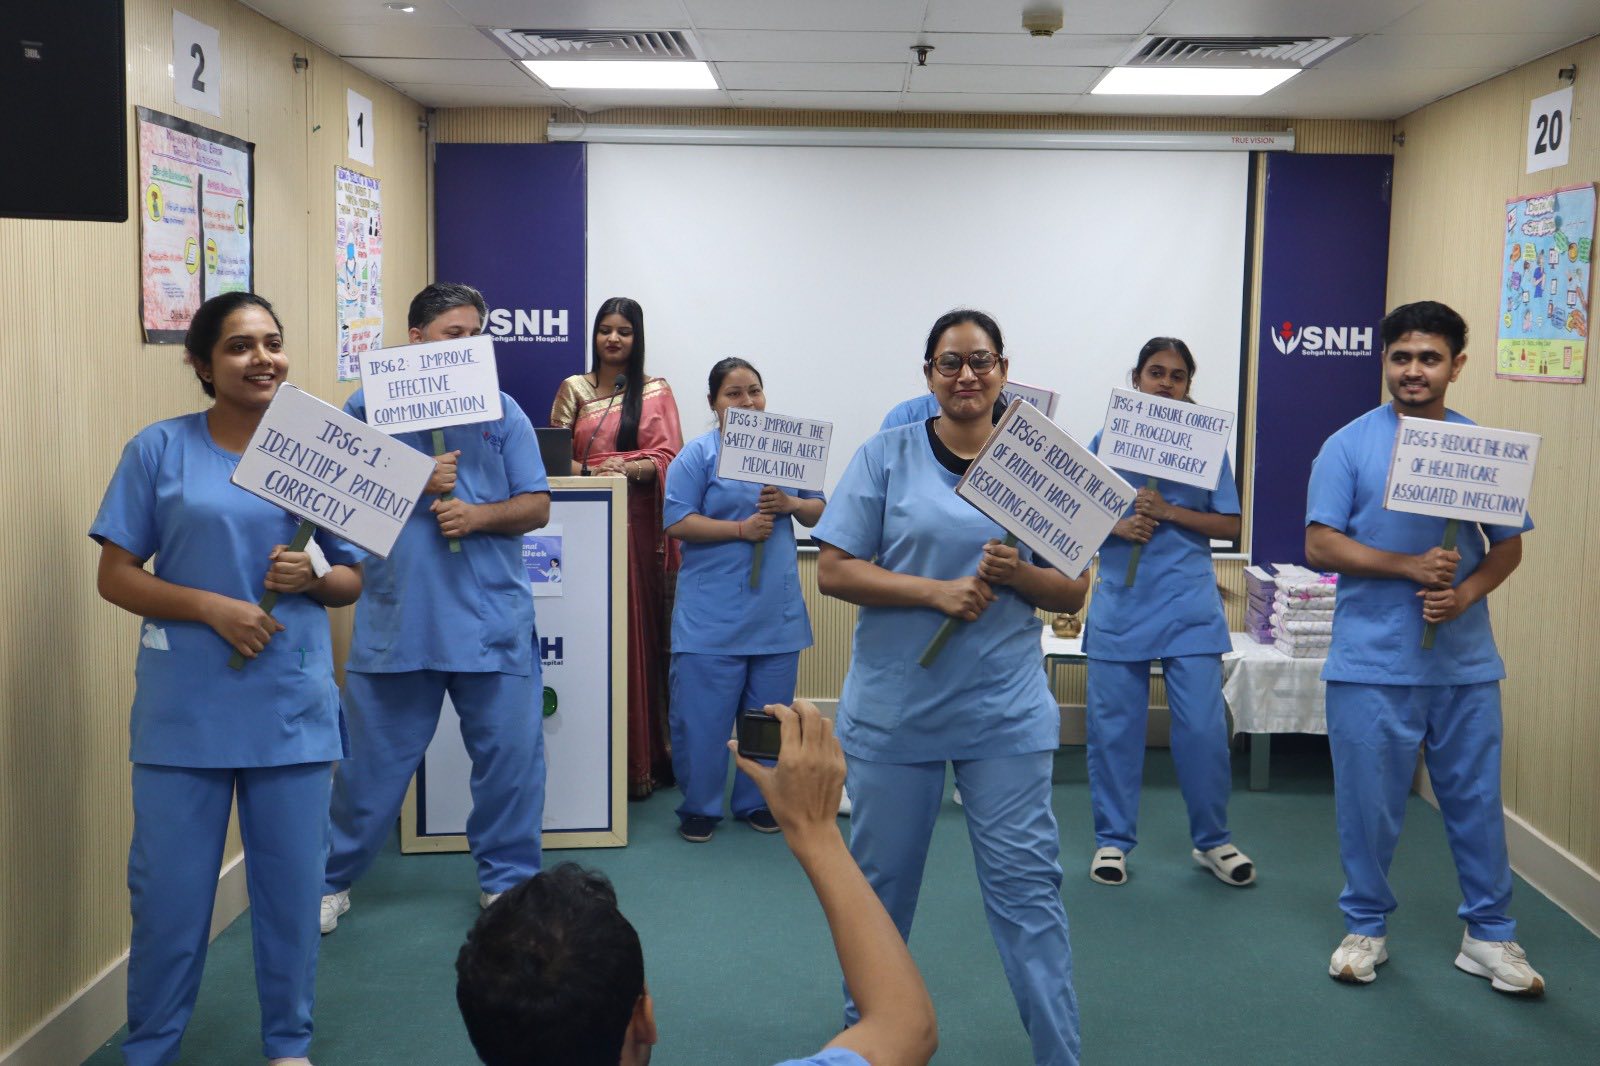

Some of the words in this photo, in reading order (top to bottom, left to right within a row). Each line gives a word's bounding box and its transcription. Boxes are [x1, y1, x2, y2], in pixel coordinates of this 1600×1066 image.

[190, 42, 205, 93] 2
[357, 112, 364, 147] 1
[1231, 136, 1249, 144] TRUE
[1250, 136, 1275, 144] VISION
[1534, 109, 1563, 155] 20
[489, 308, 568, 335] SNH
[1302, 326, 1373, 350] SNH
[419, 349, 474, 369] IMPROVE
[1302, 349, 1325, 357] Sehgal
[388, 374, 450, 399] EFFECTIVE
[374, 395, 485, 424] COMMUNICATION
[1148, 403, 1184, 424] ENSURE
[764, 416, 803, 436] IMPROVE
[810, 424, 824, 439] THE
[725, 431, 755, 449] SAFETY
[757, 437, 770, 451] OF
[772, 439, 793, 455] HIGH
[796, 443, 825, 459] ALERT
[1113, 440, 1156, 462] PATIENT
[1158, 451, 1207, 474] SURGERY
[1441, 433, 1482, 454] REDUCE
[1484, 439, 1501, 457] THE
[1502, 442, 1530, 460] RISK
[742, 456, 805, 480] MEDICATION
[1411, 457, 1427, 473] OF
[993, 443, 1011, 459] OF
[1005, 452, 1049, 492] PATIENT
[1044, 483, 1081, 519] HARM
[1045, 445, 1088, 485] REDUCE
[1083, 471, 1105, 497] THE
[1099, 485, 1128, 518] RISK
[264, 470, 356, 526] CORRECTLY
[349, 474, 413, 519] PATIENT
[1392, 483, 1457, 505] ASSOCIATED
[1462, 491, 1525, 514] INFECTION
[968, 466, 1026, 517] RESULTING
[1021, 507, 1053, 539] FROM
[1049, 528, 1083, 562] FALLS
